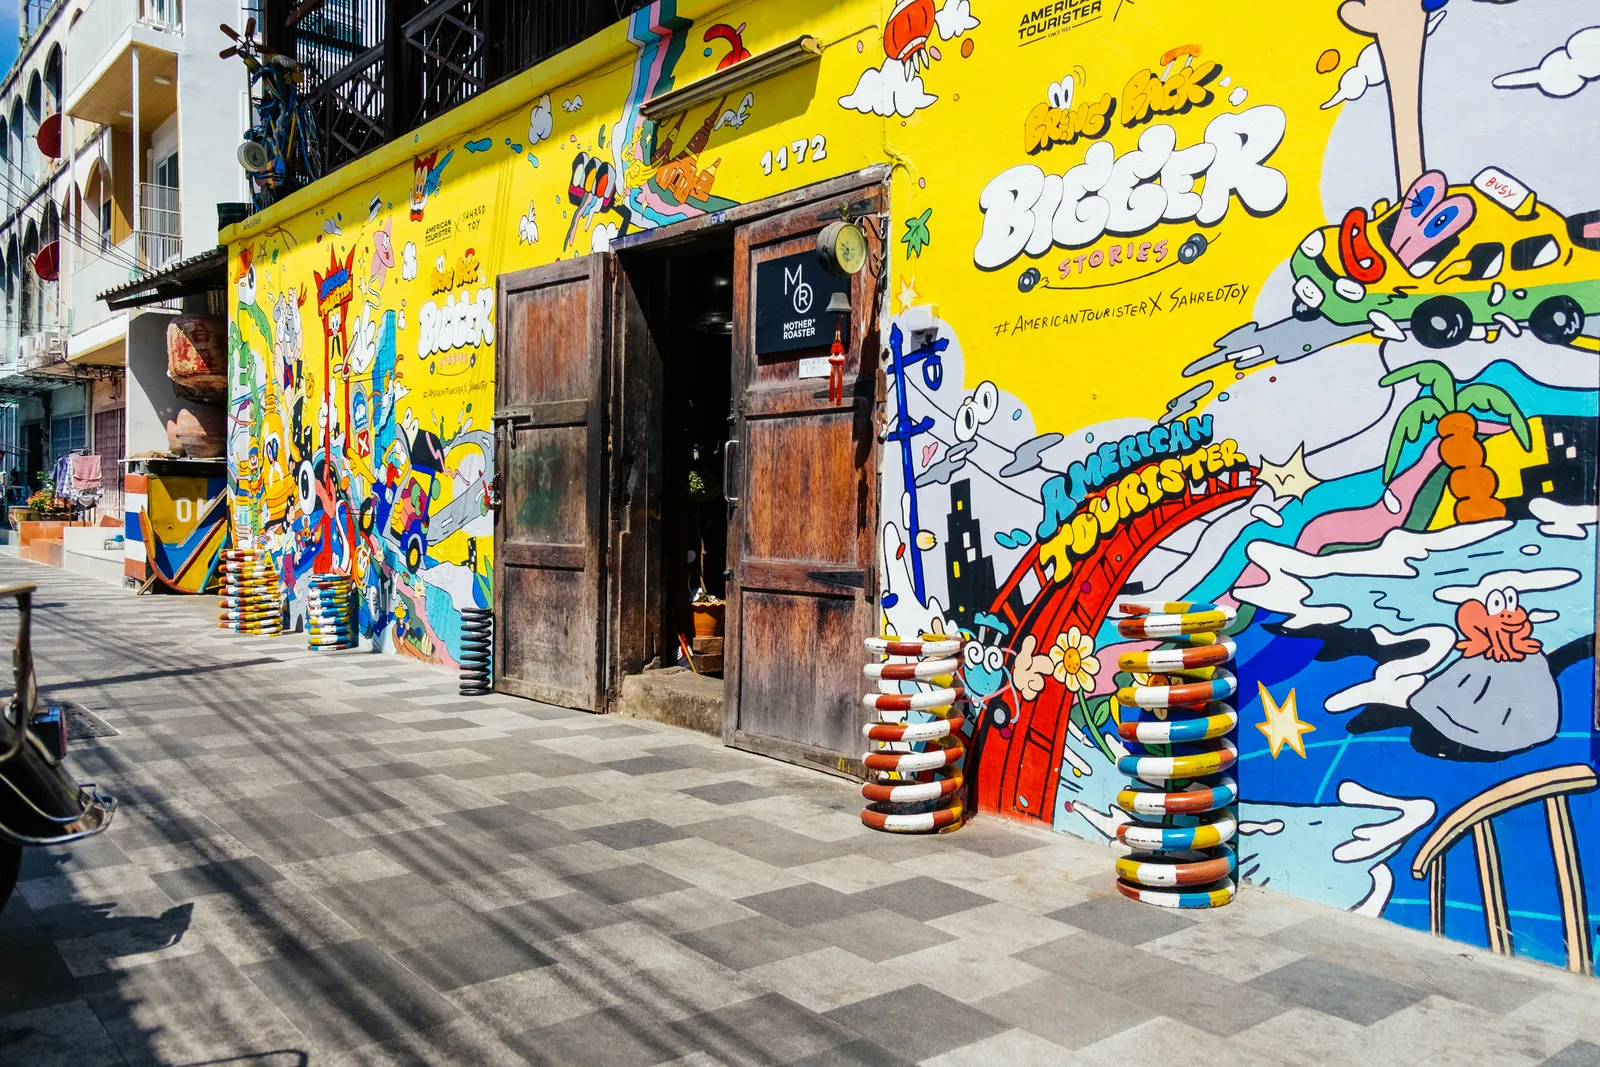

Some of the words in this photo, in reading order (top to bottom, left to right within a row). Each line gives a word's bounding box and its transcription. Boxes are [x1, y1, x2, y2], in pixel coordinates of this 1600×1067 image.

[1018, 1, 1101, 39] TOURISTER
[1120, 61, 1223, 128] BACK
[759, 134, 827, 176] 1172
[973, 104, 1288, 272] BIGGER
[1485, 177, 1516, 198] BUSY
[467, 218, 481, 233] TOY
[1058, 240, 1168, 279] STORIES
[417, 287, 494, 360] BIGGER
[783, 326, 816, 341] ROASTER
[1036, 413, 1215, 540] AMERICAN
[1038, 438, 1250, 586] TOURISTER
